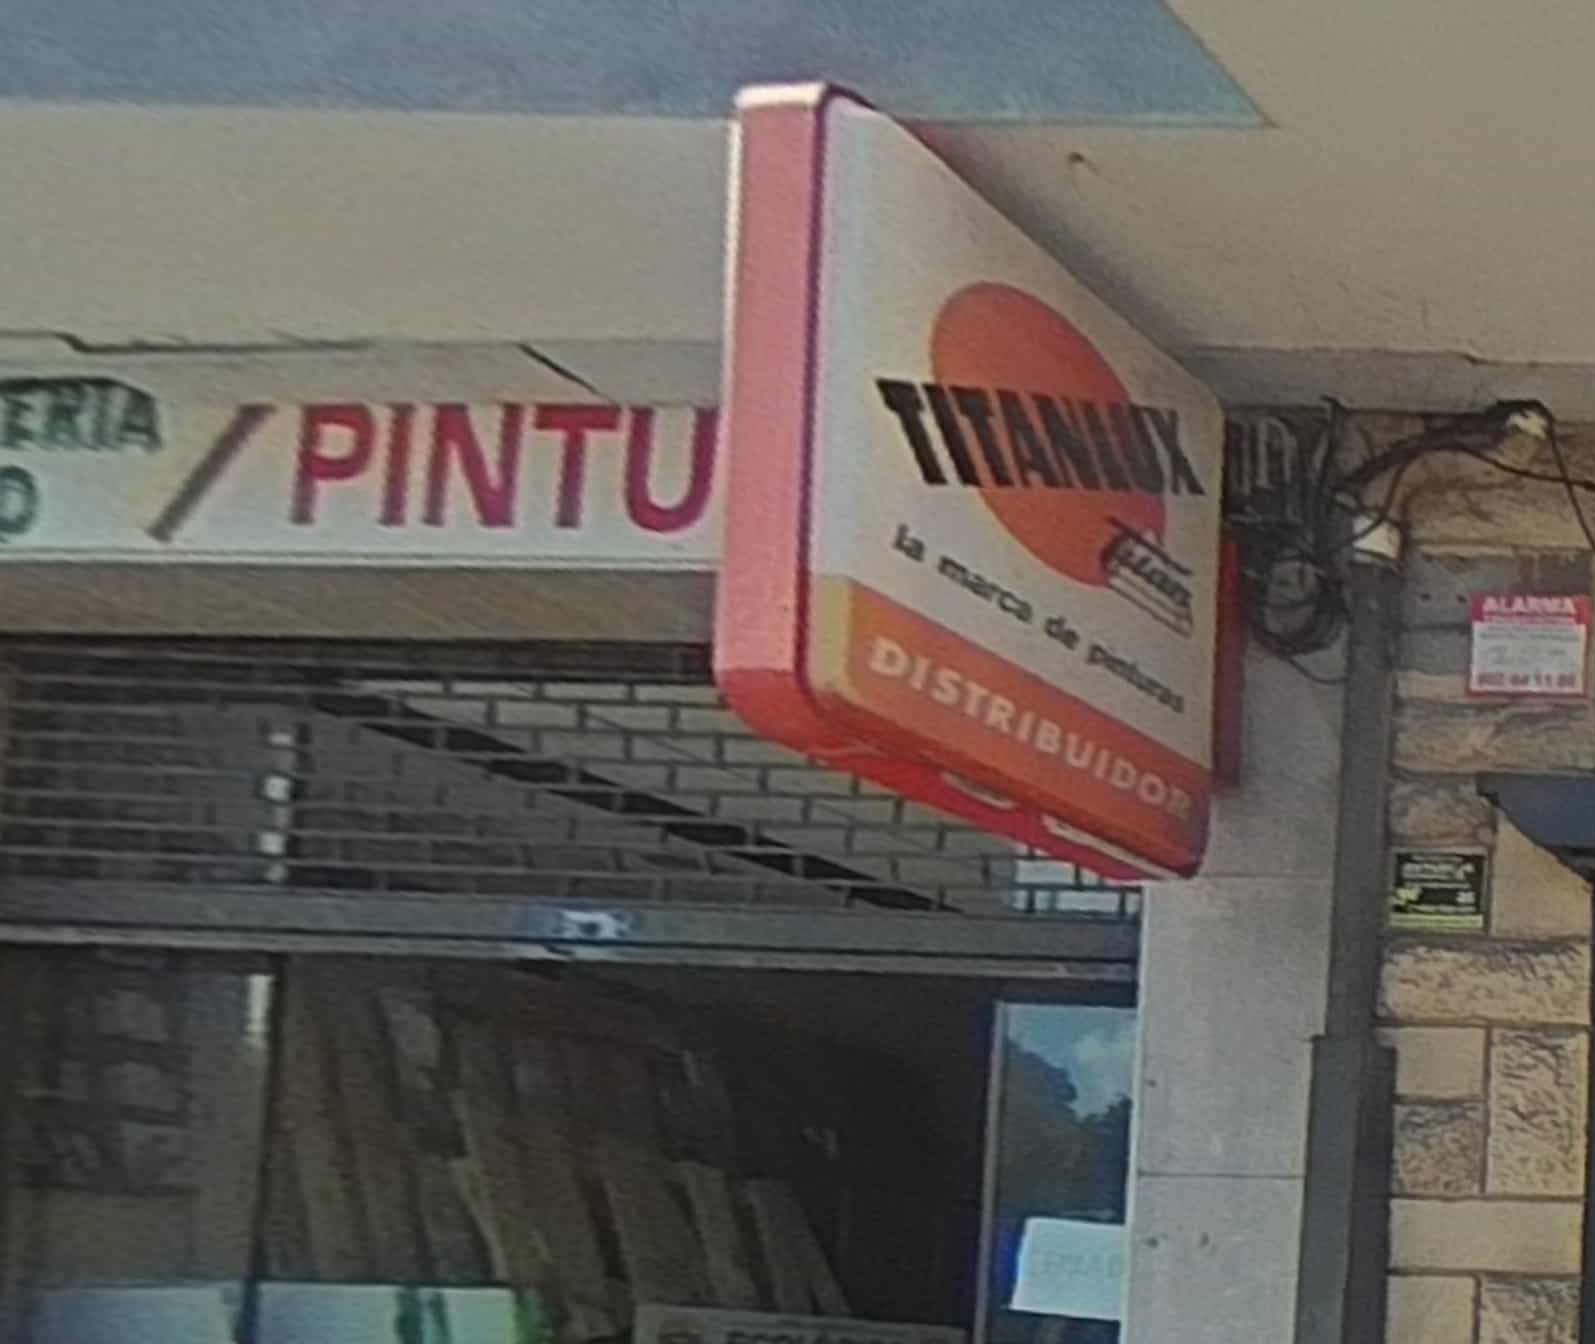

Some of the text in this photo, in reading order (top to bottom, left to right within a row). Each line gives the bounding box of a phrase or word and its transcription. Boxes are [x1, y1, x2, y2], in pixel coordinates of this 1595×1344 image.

[290, 402, 721, 533] PINTU
[875, 379, 1205, 496] TITANLUX
[892, 523, 1184, 713] la marca de pinturas
[1482, 595, 1576, 613] ALARMA
[867, 636, 1192, 820] DISTRIBUIDOR
